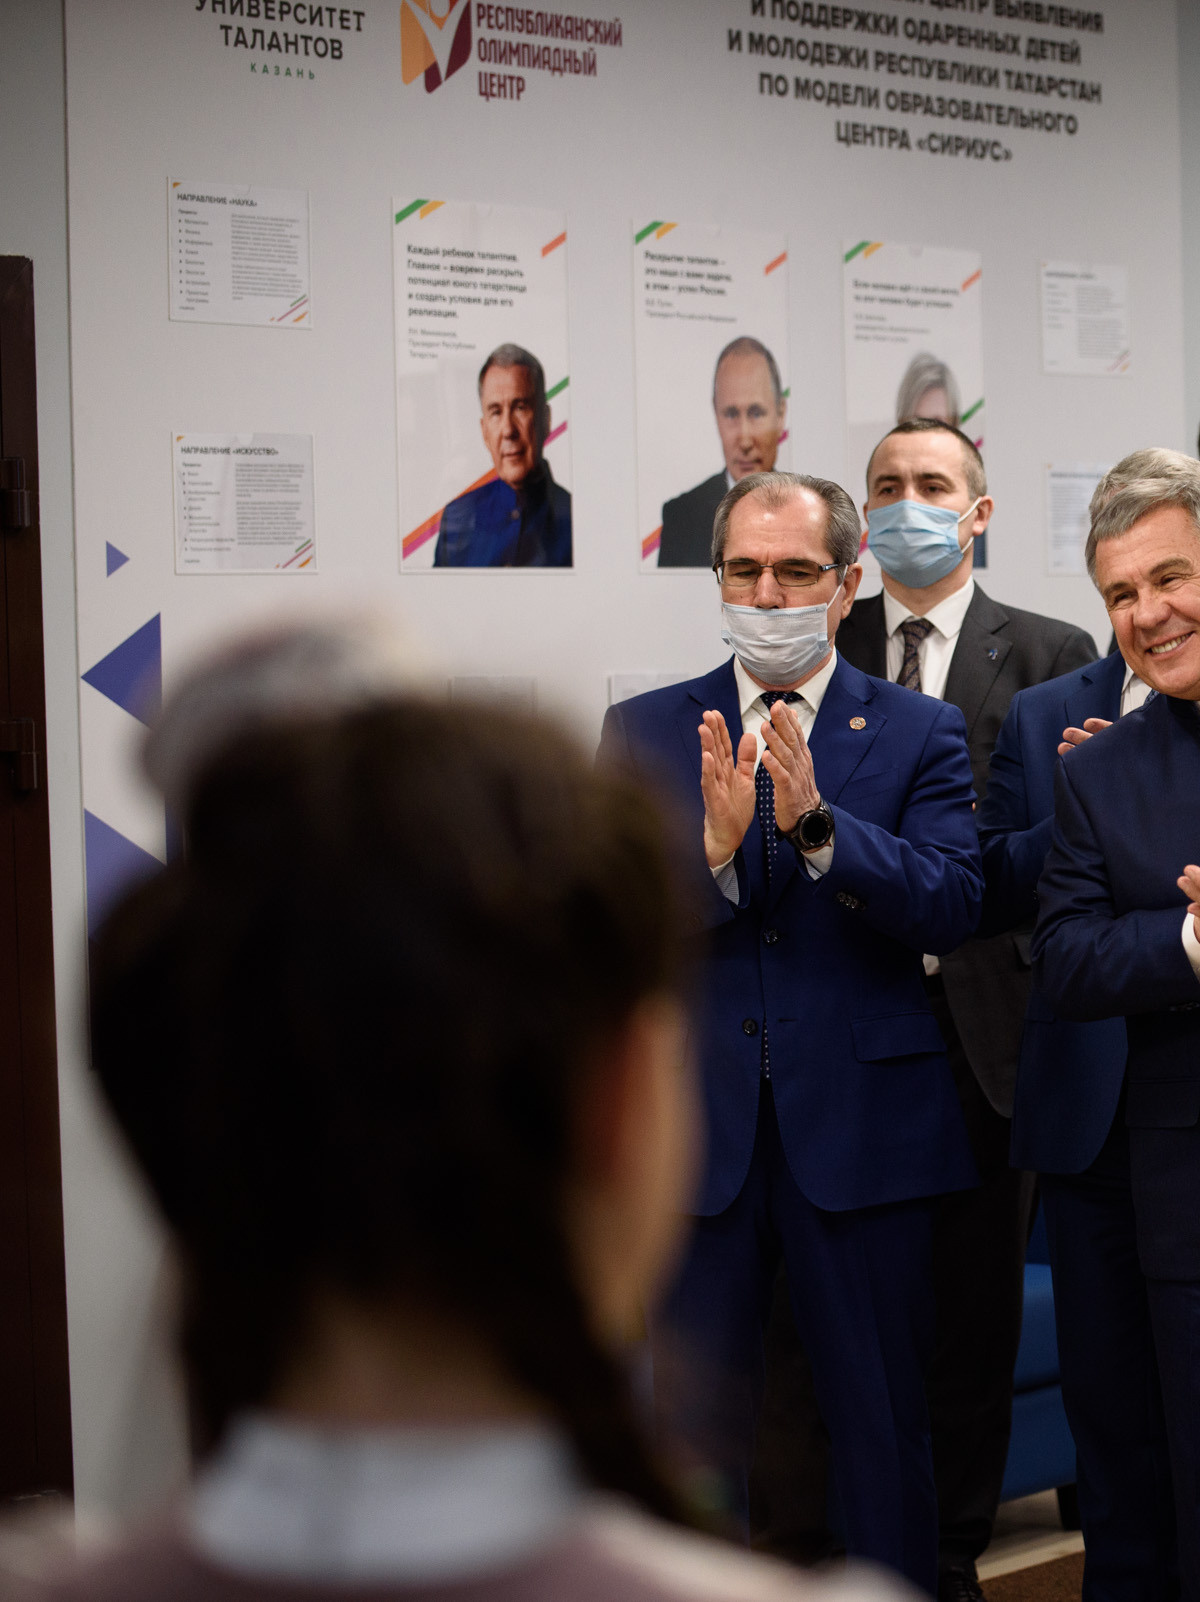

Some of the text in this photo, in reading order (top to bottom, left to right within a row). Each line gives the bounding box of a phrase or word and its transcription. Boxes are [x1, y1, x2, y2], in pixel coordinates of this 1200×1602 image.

[476, 3, 623, 47] РЕСПУБЛИКАНСКИЙ
[751, 0, 1081, 65] И ПОДДЕРЖКИ ОДАРЕННЫХ ДЕТЕЙ
[993, 0, 1104, 33] ВЫЯВЛЕНИЯ
[219, 24, 343, 60] ТАЛАНТОВ
[477, 37, 598, 77] ОЛИМПИАДНЫЙ
[250, 62, 315, 80] КАЗАНЬ
[728, 29, 1102, 103] И МОЛОДЕЖИ РЕСПУБЛИКИ ТАТАРСТАН
[478, 71, 526, 101] ЦЕНТР
[759, 72, 1078, 135] ПО МОДЕЛИ ОБРАЗОВАТЕЛЬНОГО
[836, 120, 1012, 162] ЦЕНТРА «СИРИУС»
[177, 193, 227, 205] НАПРАВЛЕНИЕ
[407, 244, 440, 256] Каждый
[442, 248, 475, 260] ребенок
[407, 260, 441, 271] Главное
[450, 264, 484, 275] вовремя
[408, 277, 450, 288] потенциал
[181, 446, 279, 456] НАПРАВЛЕНИЕ «ИСКУССТВО»
